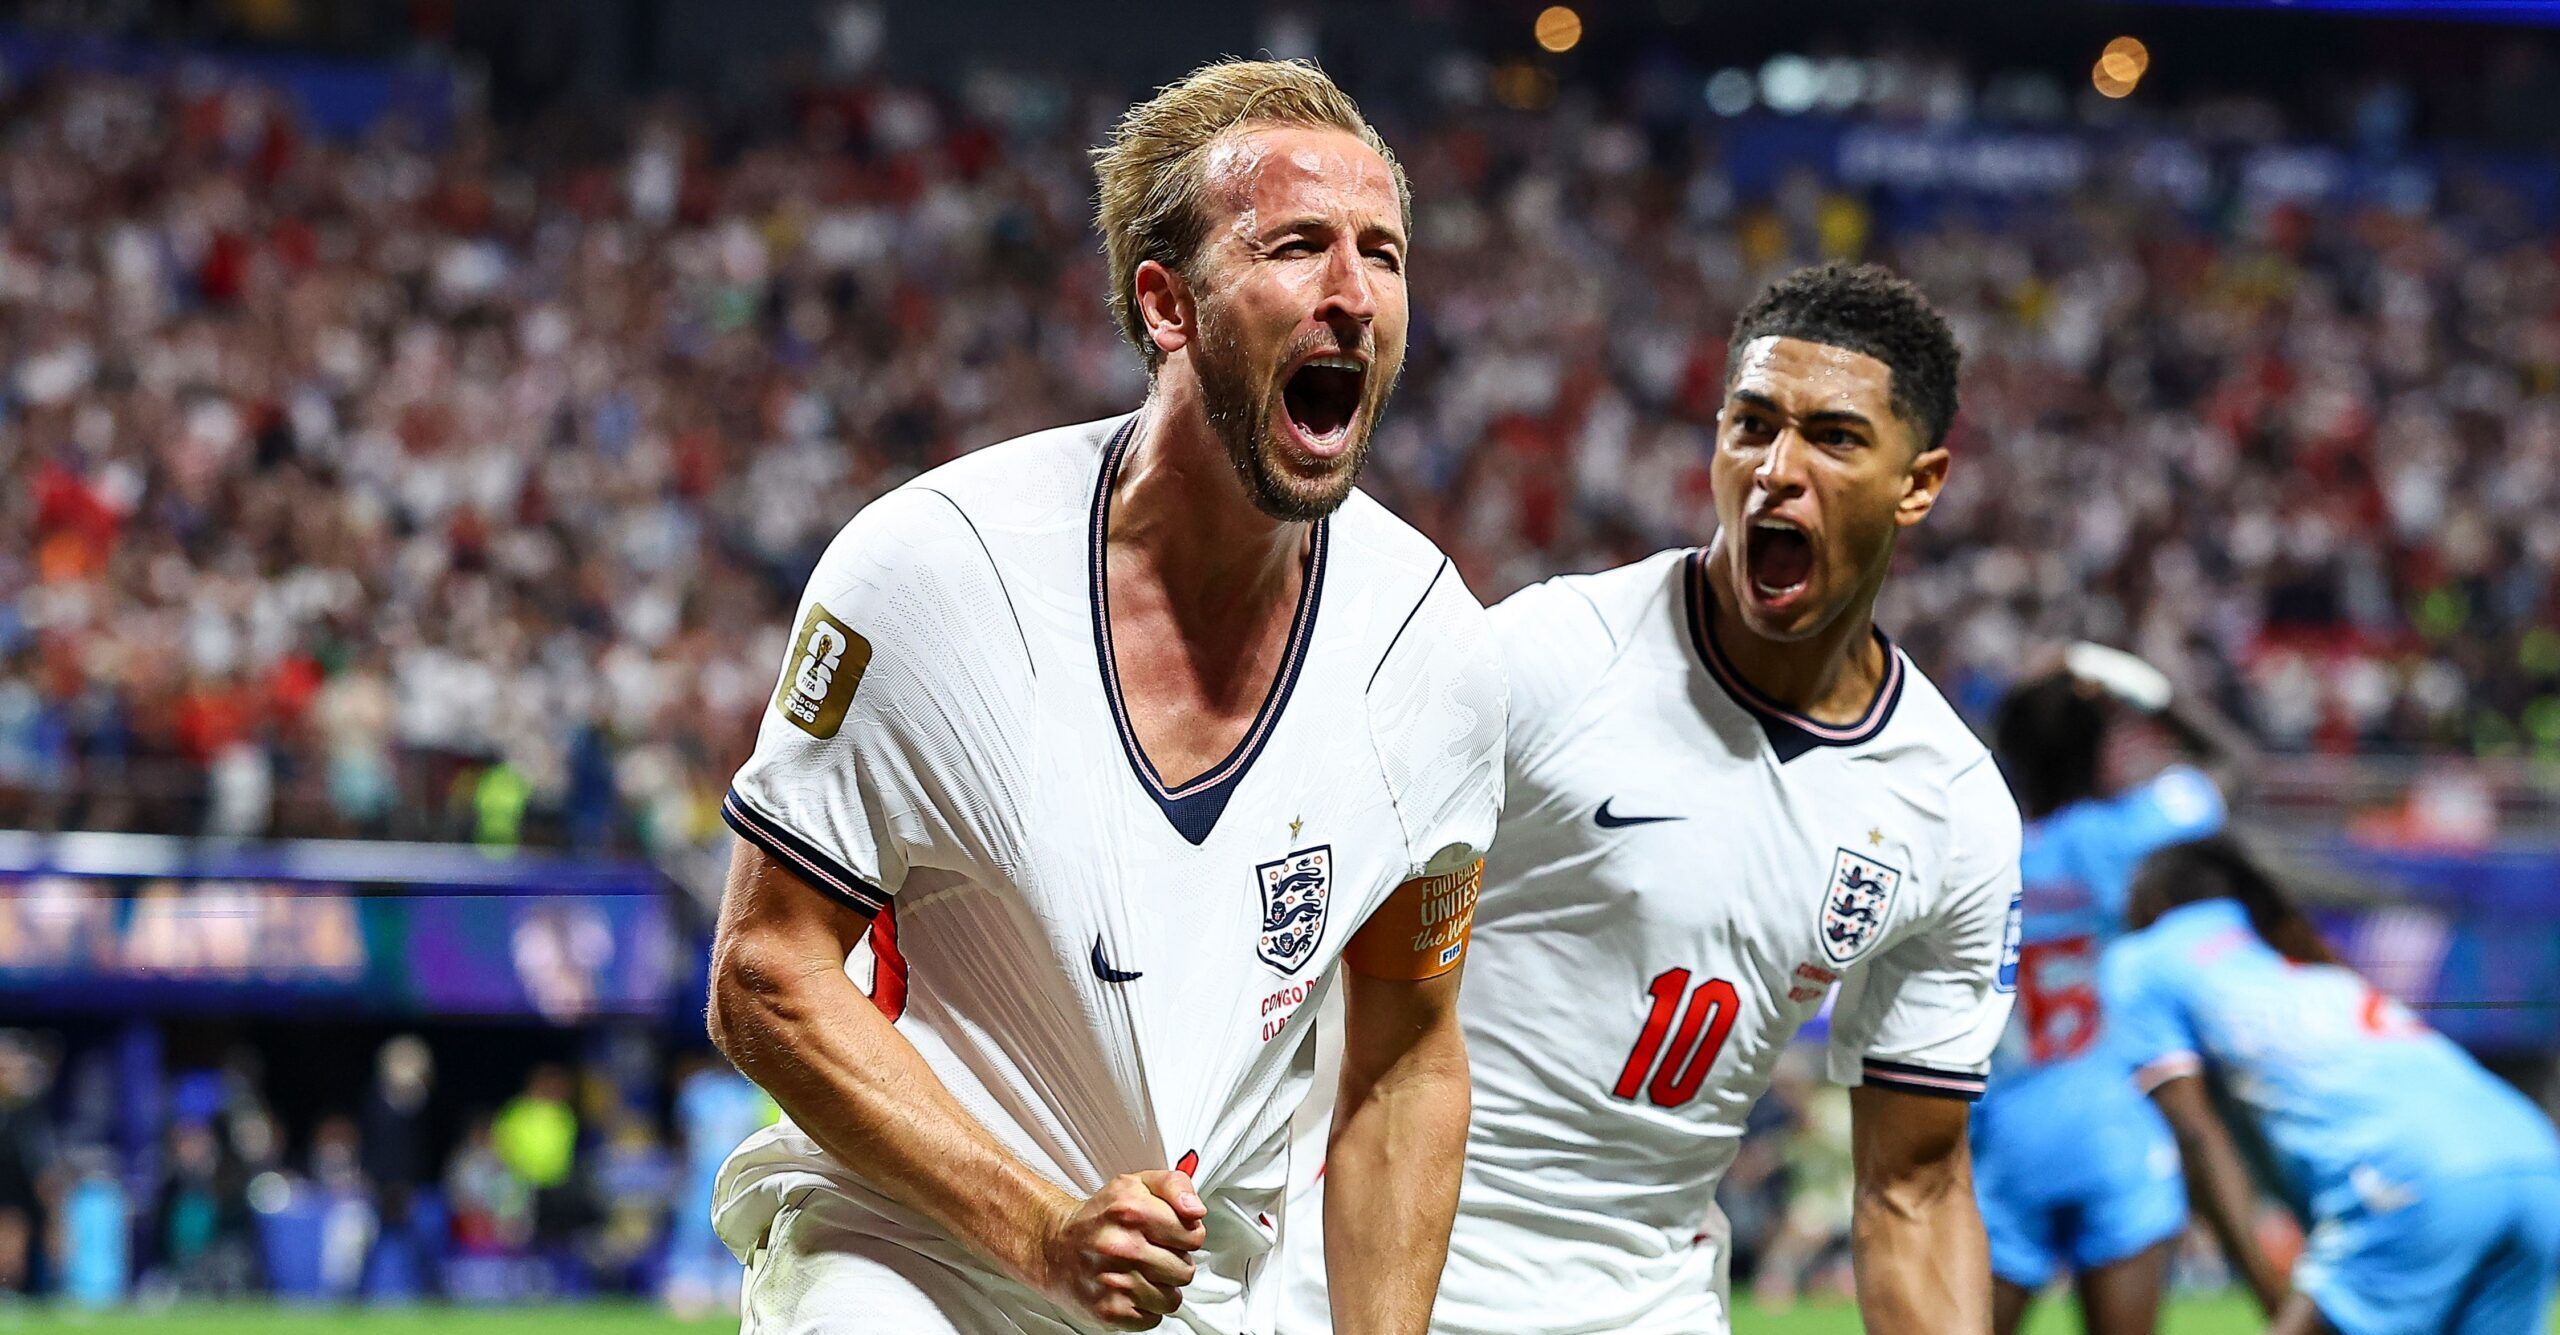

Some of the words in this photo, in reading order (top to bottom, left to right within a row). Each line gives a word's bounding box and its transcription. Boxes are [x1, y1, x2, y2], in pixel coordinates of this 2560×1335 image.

[801, 676, 816, 692] FIFA
[783, 694, 816, 724] 2026
[804, 700, 820, 712] CUP
[1421, 861, 1480, 900] FOOTBALL
[1421, 874, 1479, 926] UNITES
[1411, 928, 1446, 951] the
[1261, 987, 1303, 1017] CONGO
[1612, 966, 1740, 1109] 10
